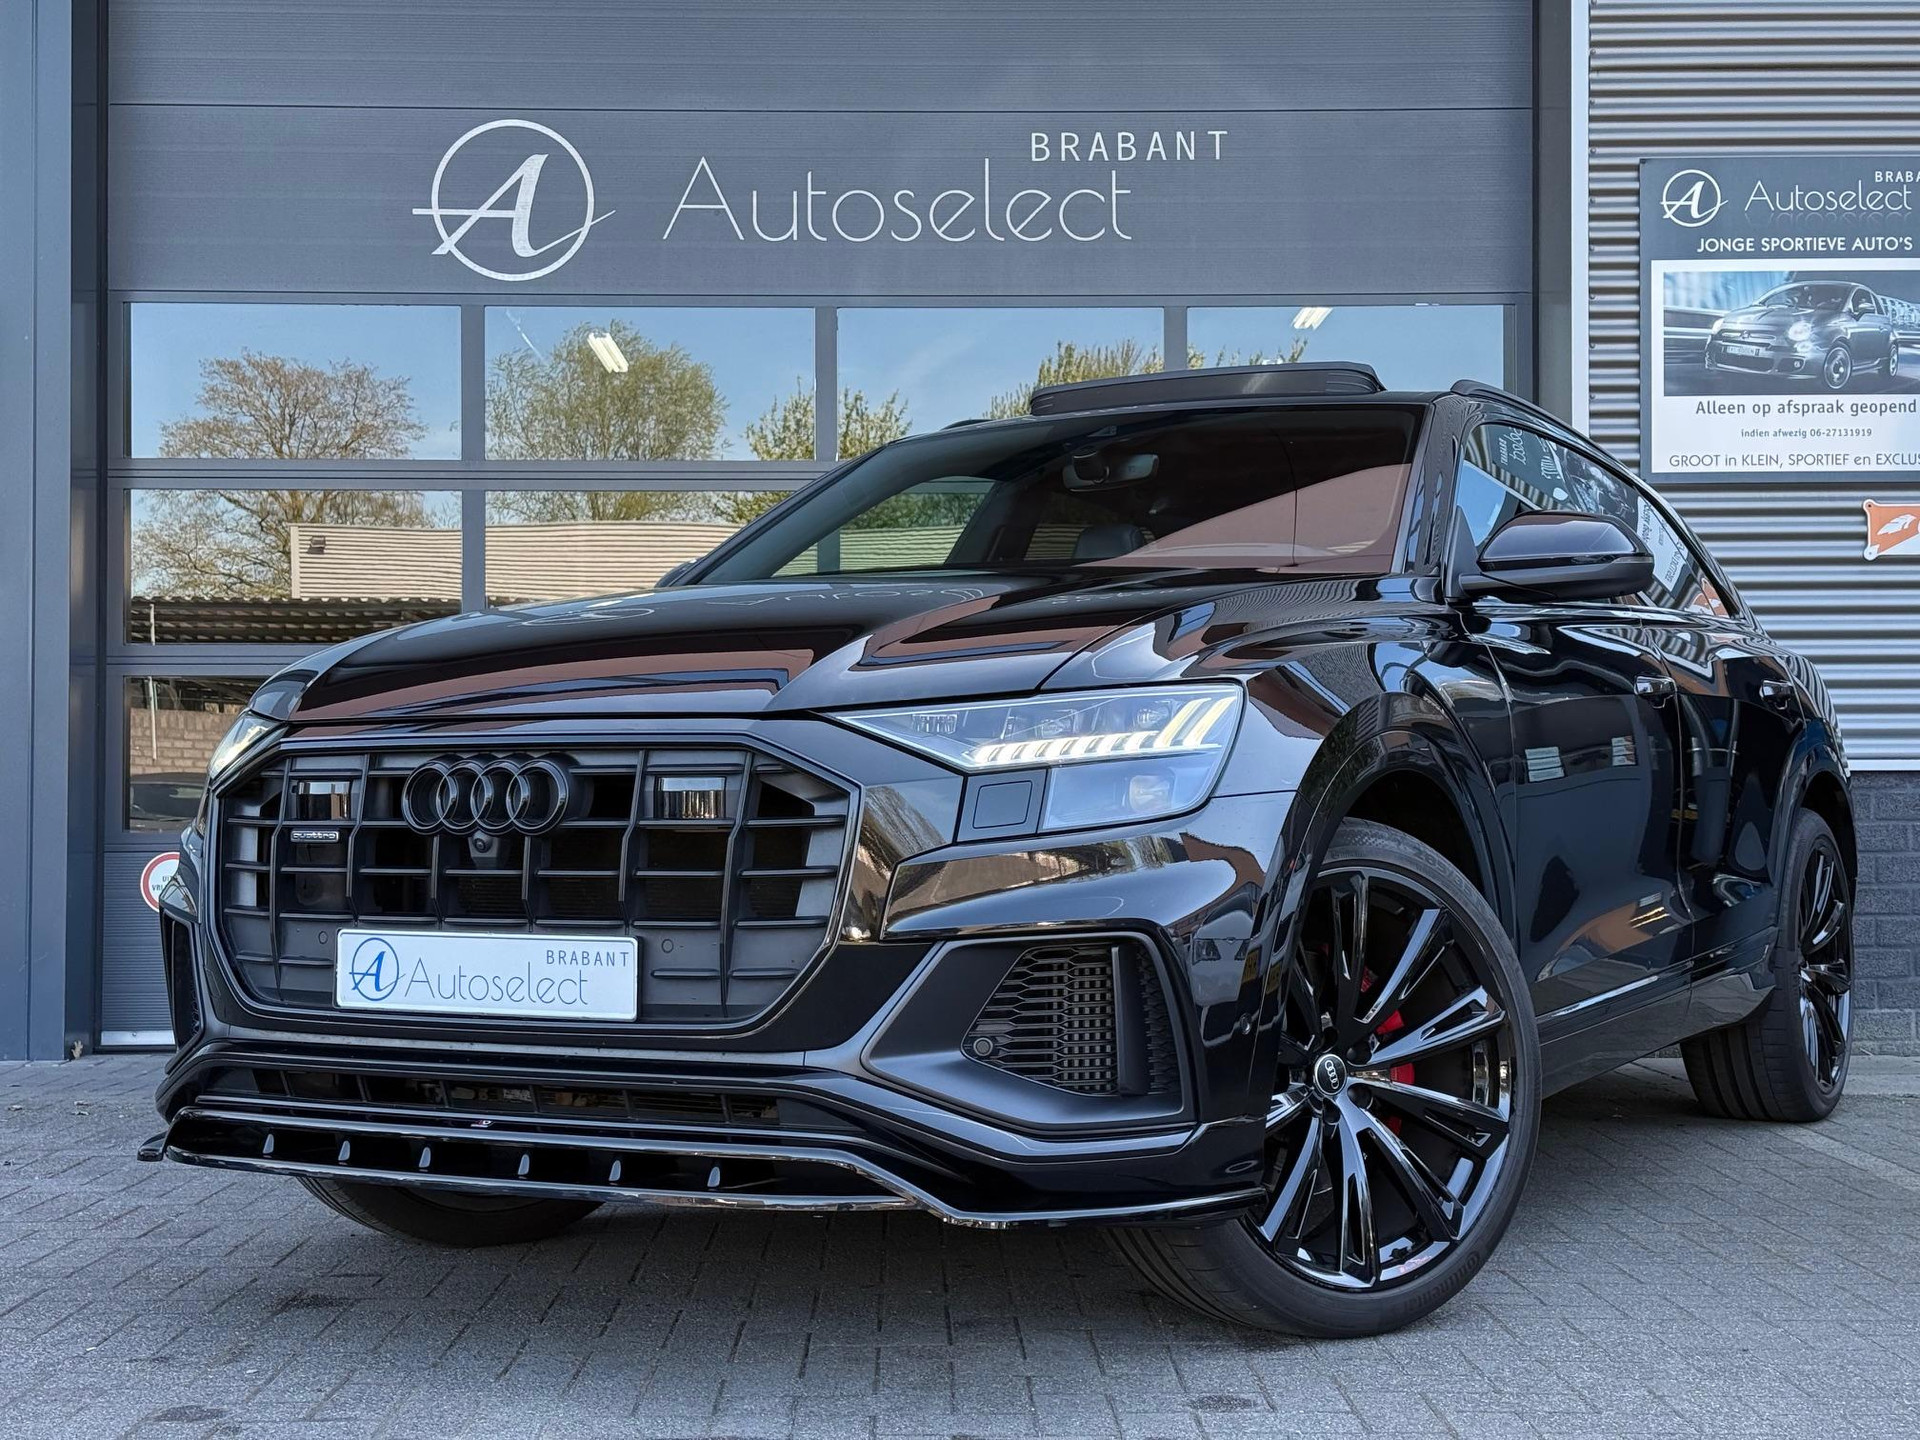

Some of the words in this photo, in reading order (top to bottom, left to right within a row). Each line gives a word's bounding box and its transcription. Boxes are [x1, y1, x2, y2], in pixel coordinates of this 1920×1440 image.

[1031, 130, 1228, 162] BRABANT
[662, 156, 1133, 242] Autoselect
[1744, 179, 1913, 212] Autoselect
[1697, 237, 1755, 253] JONGE
[1761, 236, 1847, 252] SPORTIEVE
[1851, 236, 1913, 251] AUTO'S
[1695, 400, 1746, 416] Alleen
[1752, 403, 1771, 418] op
[1777, 399, 1845, 418] afspraak
[1850, 398, 1917, 417] geopend
[1740, 428, 1770, 438] indien
[1773, 428, 1807, 440] afwezig
[1809, 427, 1872, 438] 06-27131919
[1669, 454, 1721, 467] GROOT
[1725, 453, 1737, 467] in
[1741, 453, 1784, 469] KLEIN,
[1788, 453, 1850, 466] SPORTIEF
[1853, 455, 1871, 467] en
[546, 949, 630, 968] BRABANT
[404, 957, 591, 1006] Autoselect
